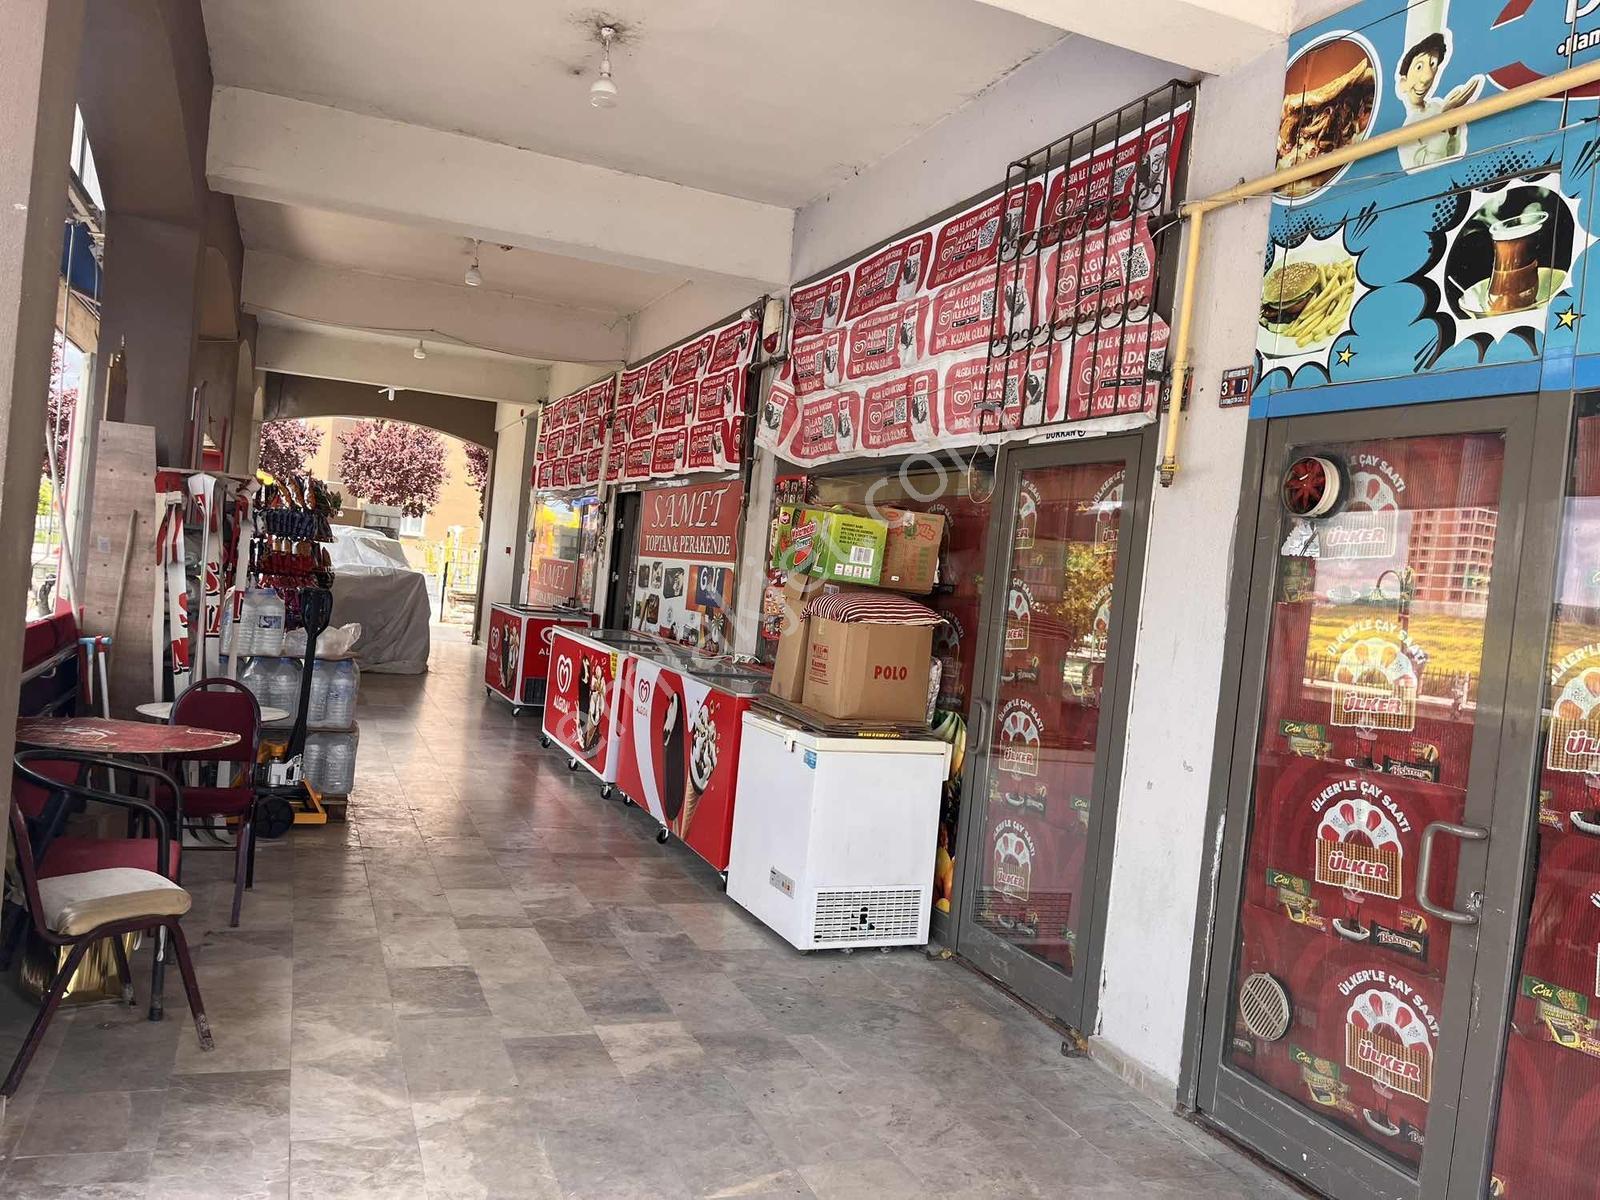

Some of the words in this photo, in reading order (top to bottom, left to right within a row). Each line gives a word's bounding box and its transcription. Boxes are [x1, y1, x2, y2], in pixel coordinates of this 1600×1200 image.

[1360, 454, 1380, 467] ÇAY
[1380, 461, 1406, 493] SAATİ
[651, 483, 732, 528] SAMET
[645, 535, 672, 552] TOPTAN
[672, 536, 678, 552] &
[679, 535, 731, 555] PERAKENDE
[1327, 525, 1385, 546] ÜLKER
[1006, 628, 1024, 640] KER
[873, 666, 908, 681] POLO
[1343, 690, 1403, 715] ÜLKER
[1565, 729, 1600, 755] ÜL
[1311, 780, 1357, 812] ÜLKER'LE
[1360, 781, 1382, 798] ÇAY
[1381, 795, 1411, 832] SAATİ
[1329, 851, 1389, 882] ÜLKER
[1338, 969, 1386, 995] ÜLKER'LE
[1388, 974, 1413, 995] ÇAY
[1412, 994, 1440, 1037] SAATİ
[1358, 1039, 1421, 1082] ÜLKER
